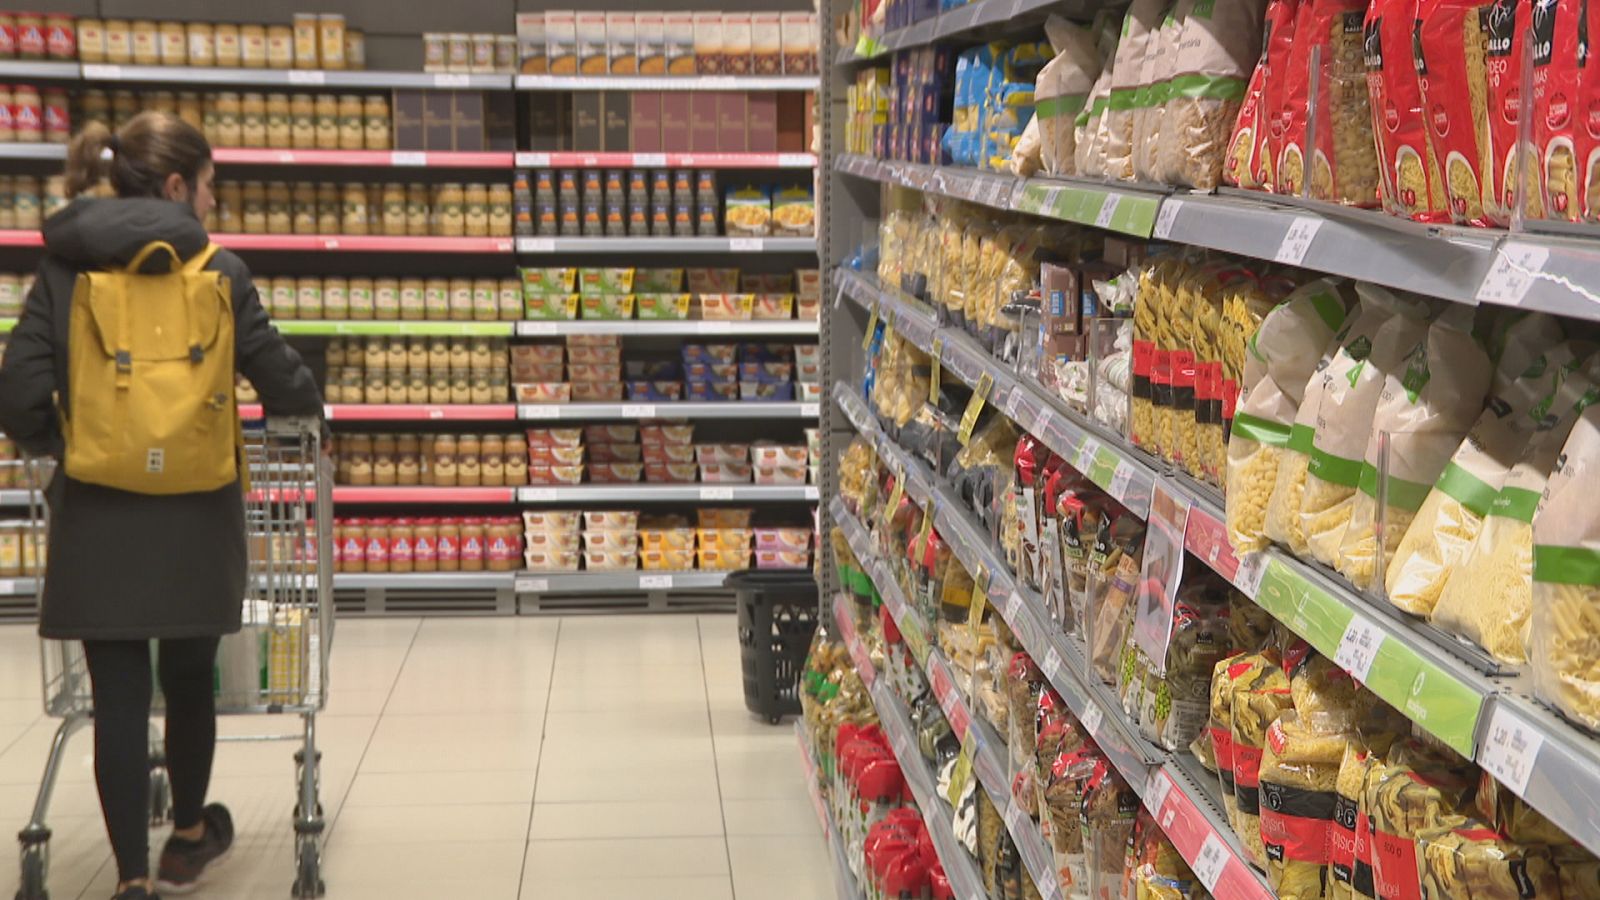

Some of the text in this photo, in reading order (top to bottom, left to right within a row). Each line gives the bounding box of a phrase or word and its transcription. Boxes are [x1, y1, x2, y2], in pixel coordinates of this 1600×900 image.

[1488, 37, 1510, 51] ALLO
[1534, 41, 1551, 59] LLO
[1489, 59, 1507, 74] DEO
